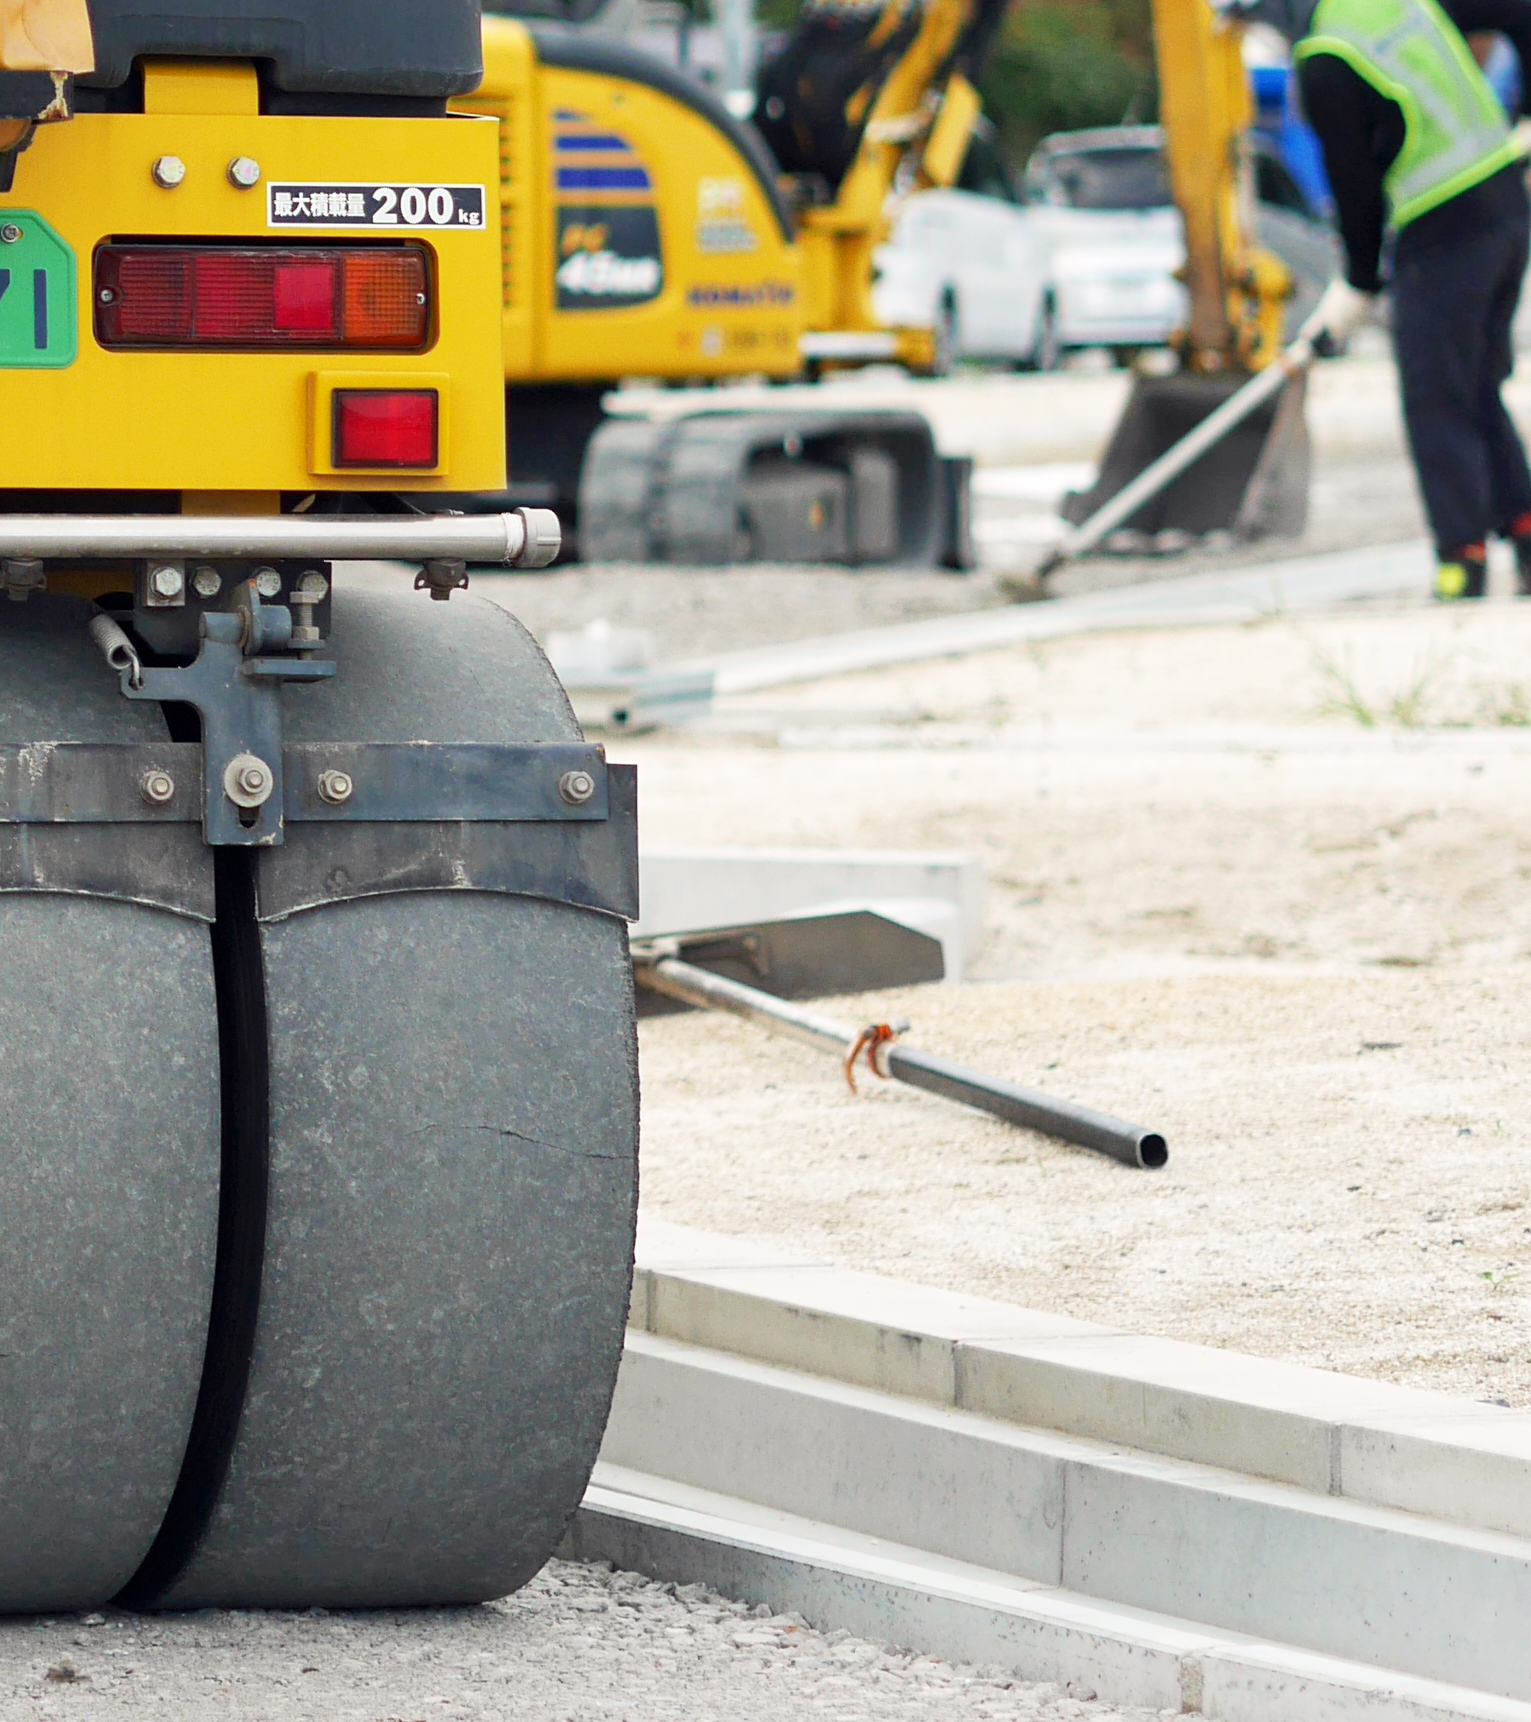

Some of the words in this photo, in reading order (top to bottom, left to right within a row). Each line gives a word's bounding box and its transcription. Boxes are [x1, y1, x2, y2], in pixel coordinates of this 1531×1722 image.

[274, 192, 365, 217] 最大積載量
[372, 187, 454, 224] 200
[458, 209, 480, 225] kg
